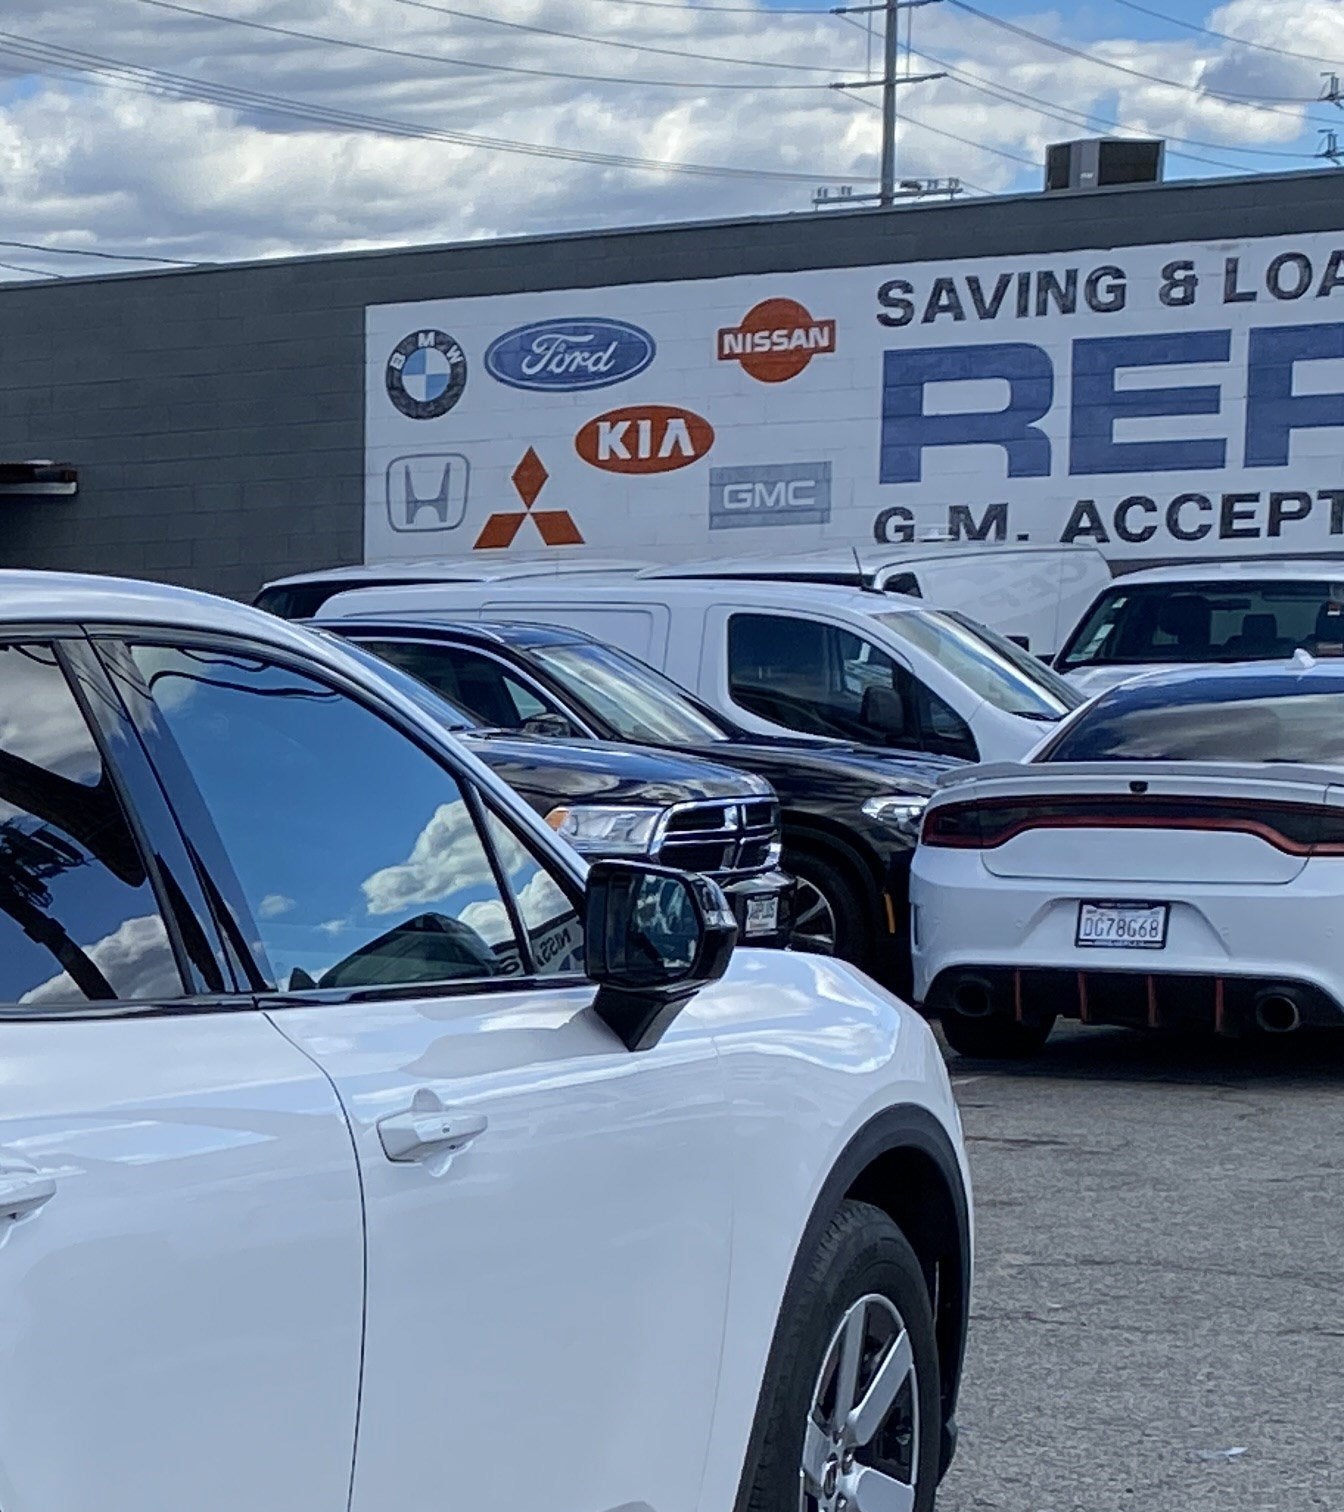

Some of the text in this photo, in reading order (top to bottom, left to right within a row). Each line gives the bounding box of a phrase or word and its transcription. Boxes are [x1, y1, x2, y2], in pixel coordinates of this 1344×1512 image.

[875, 265, 1128, 328] SAVING
[1158, 259, 1199, 307] &
[389, 331, 465, 371] BMW
[520, 333, 617, 375] Ford
[722, 326, 831, 356] NISSAN
[596, 417, 695, 462] KIA
[722, 480, 816, 511] GMC
[872, 502, 1031, 545] GM.
